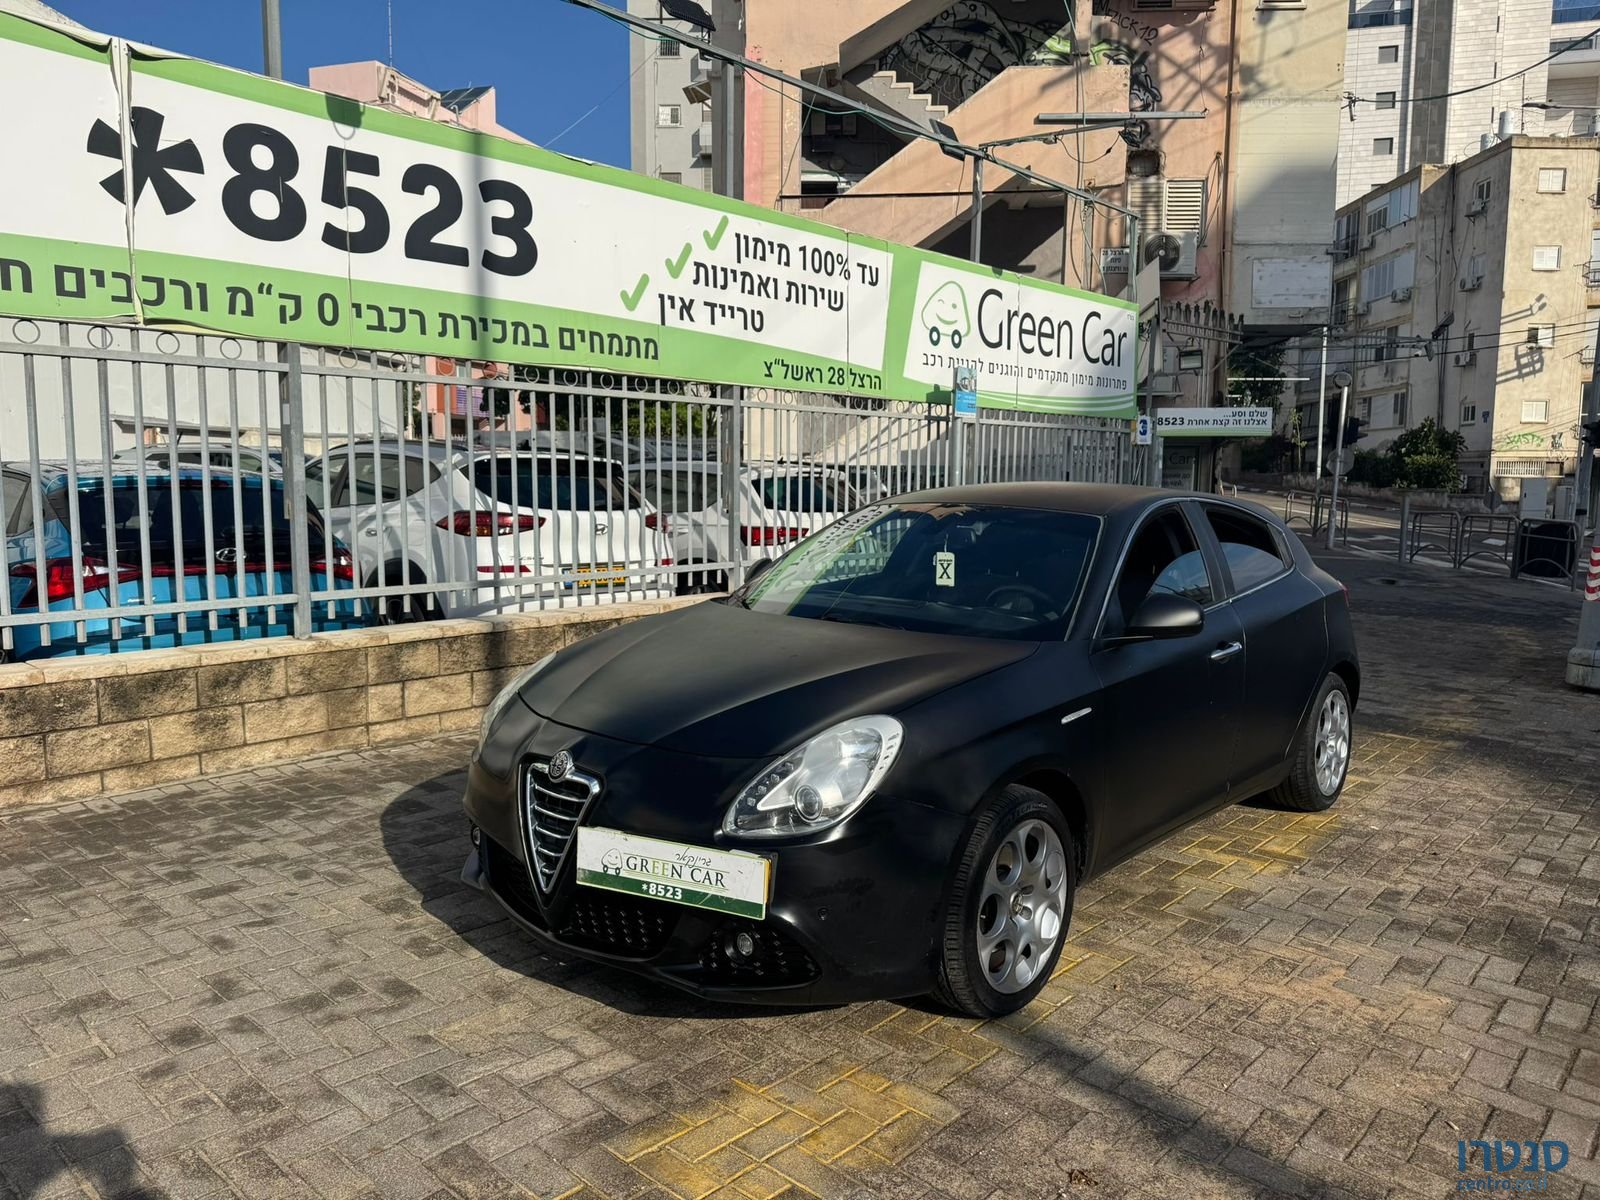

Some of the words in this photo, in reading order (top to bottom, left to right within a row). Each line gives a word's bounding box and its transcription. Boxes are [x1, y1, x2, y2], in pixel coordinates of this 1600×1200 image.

[734, 232, 791, 267] מימון
[798, 245, 851, 281] 100%
[54, 264, 208, 312] ורכבים
[692, 261, 779, 300] ואמינות
[857, 262, 879, 287] עד
[317, 293, 340, 327] 0
[658, 293, 696, 326] אין
[785, 280, 844, 312] שירות
[352, 302, 427, 336] רכבי
[438, 312, 549, 348] במכירת
[703, 300, 764, 333] טרייד
[977, 288, 1074, 361] Green
[1082, 311, 1127, 367] Car
[559, 326, 659, 361] מתמחים
[827, 367, 846, 385] 28
[922, 353, 943, 367] רכב
[988, 362, 1024, 378] והוגנים
[1027, 367, 1069, 384] מתקדמים
[849, 368, 883, 390] הרצל
[1072, 373, 1093, 387] מימון
[1157, 417, 1185, 426] 8523
[1244, 418, 1267, 426] אצלנו
[938, 562, 952, 579] X
[626, 856, 683, 880] GREEN
[690, 867, 726, 888] CAR
